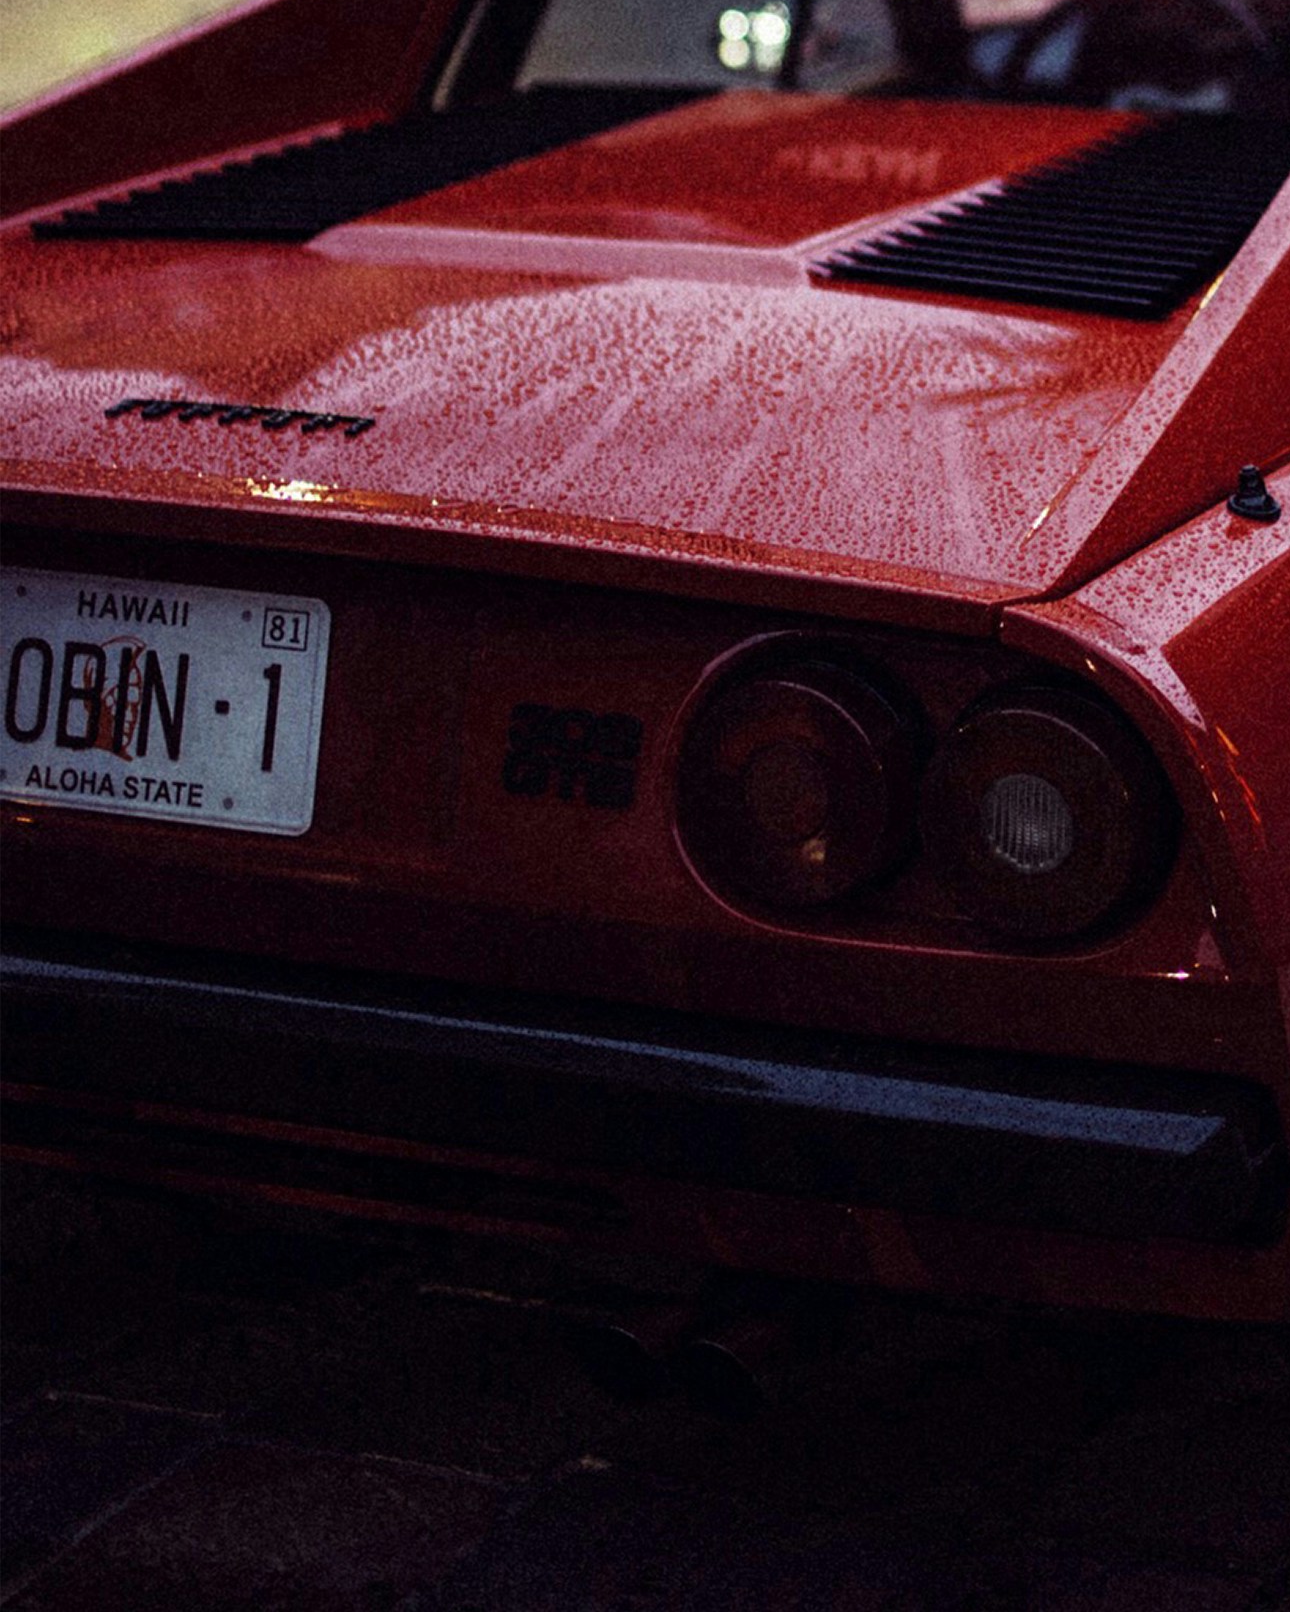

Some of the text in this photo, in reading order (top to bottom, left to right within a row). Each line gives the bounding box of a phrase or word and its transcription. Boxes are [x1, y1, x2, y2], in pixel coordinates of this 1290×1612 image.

[77, 590, 190, 627] HAWAII
[269, 614, 301, 645] 81
[25, 765, 204, 808] ALOHA STATE
